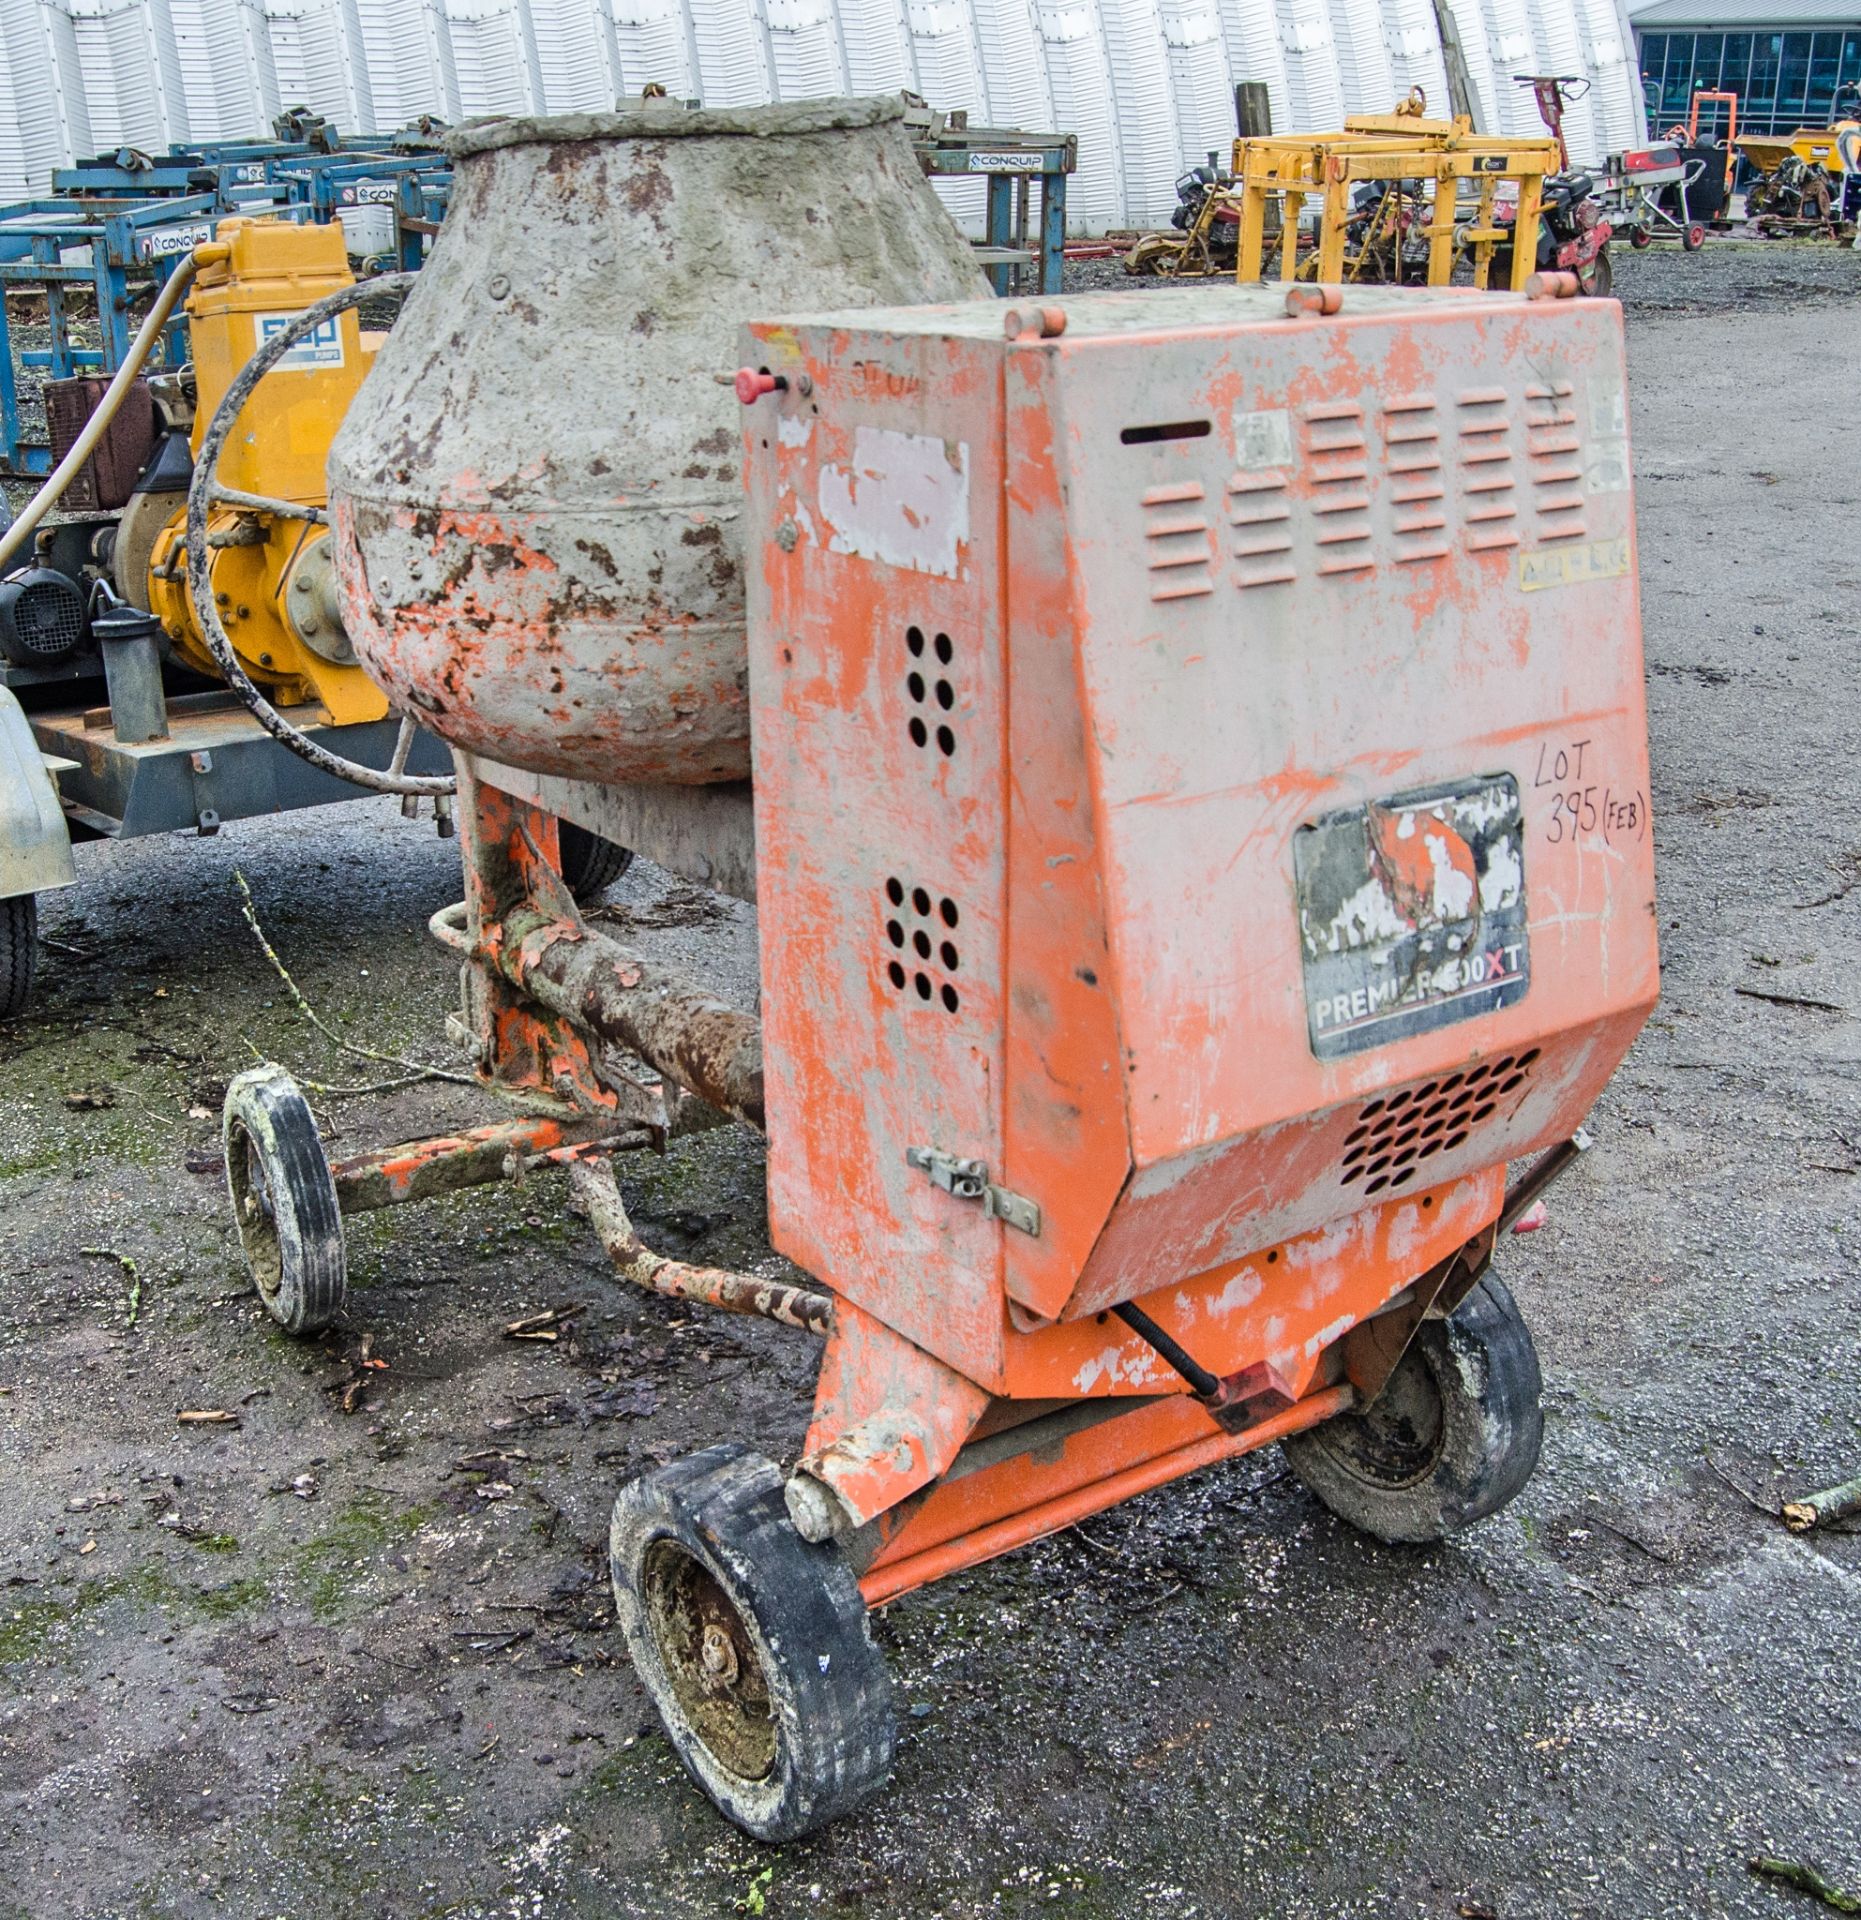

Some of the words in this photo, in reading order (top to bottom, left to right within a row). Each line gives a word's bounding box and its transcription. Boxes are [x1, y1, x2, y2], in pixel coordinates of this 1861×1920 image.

[981, 156, 1042, 167] CONQUIP
[1535, 739, 1591, 787] LOT
[1315, 971, 1436, 1029] PREMIER
